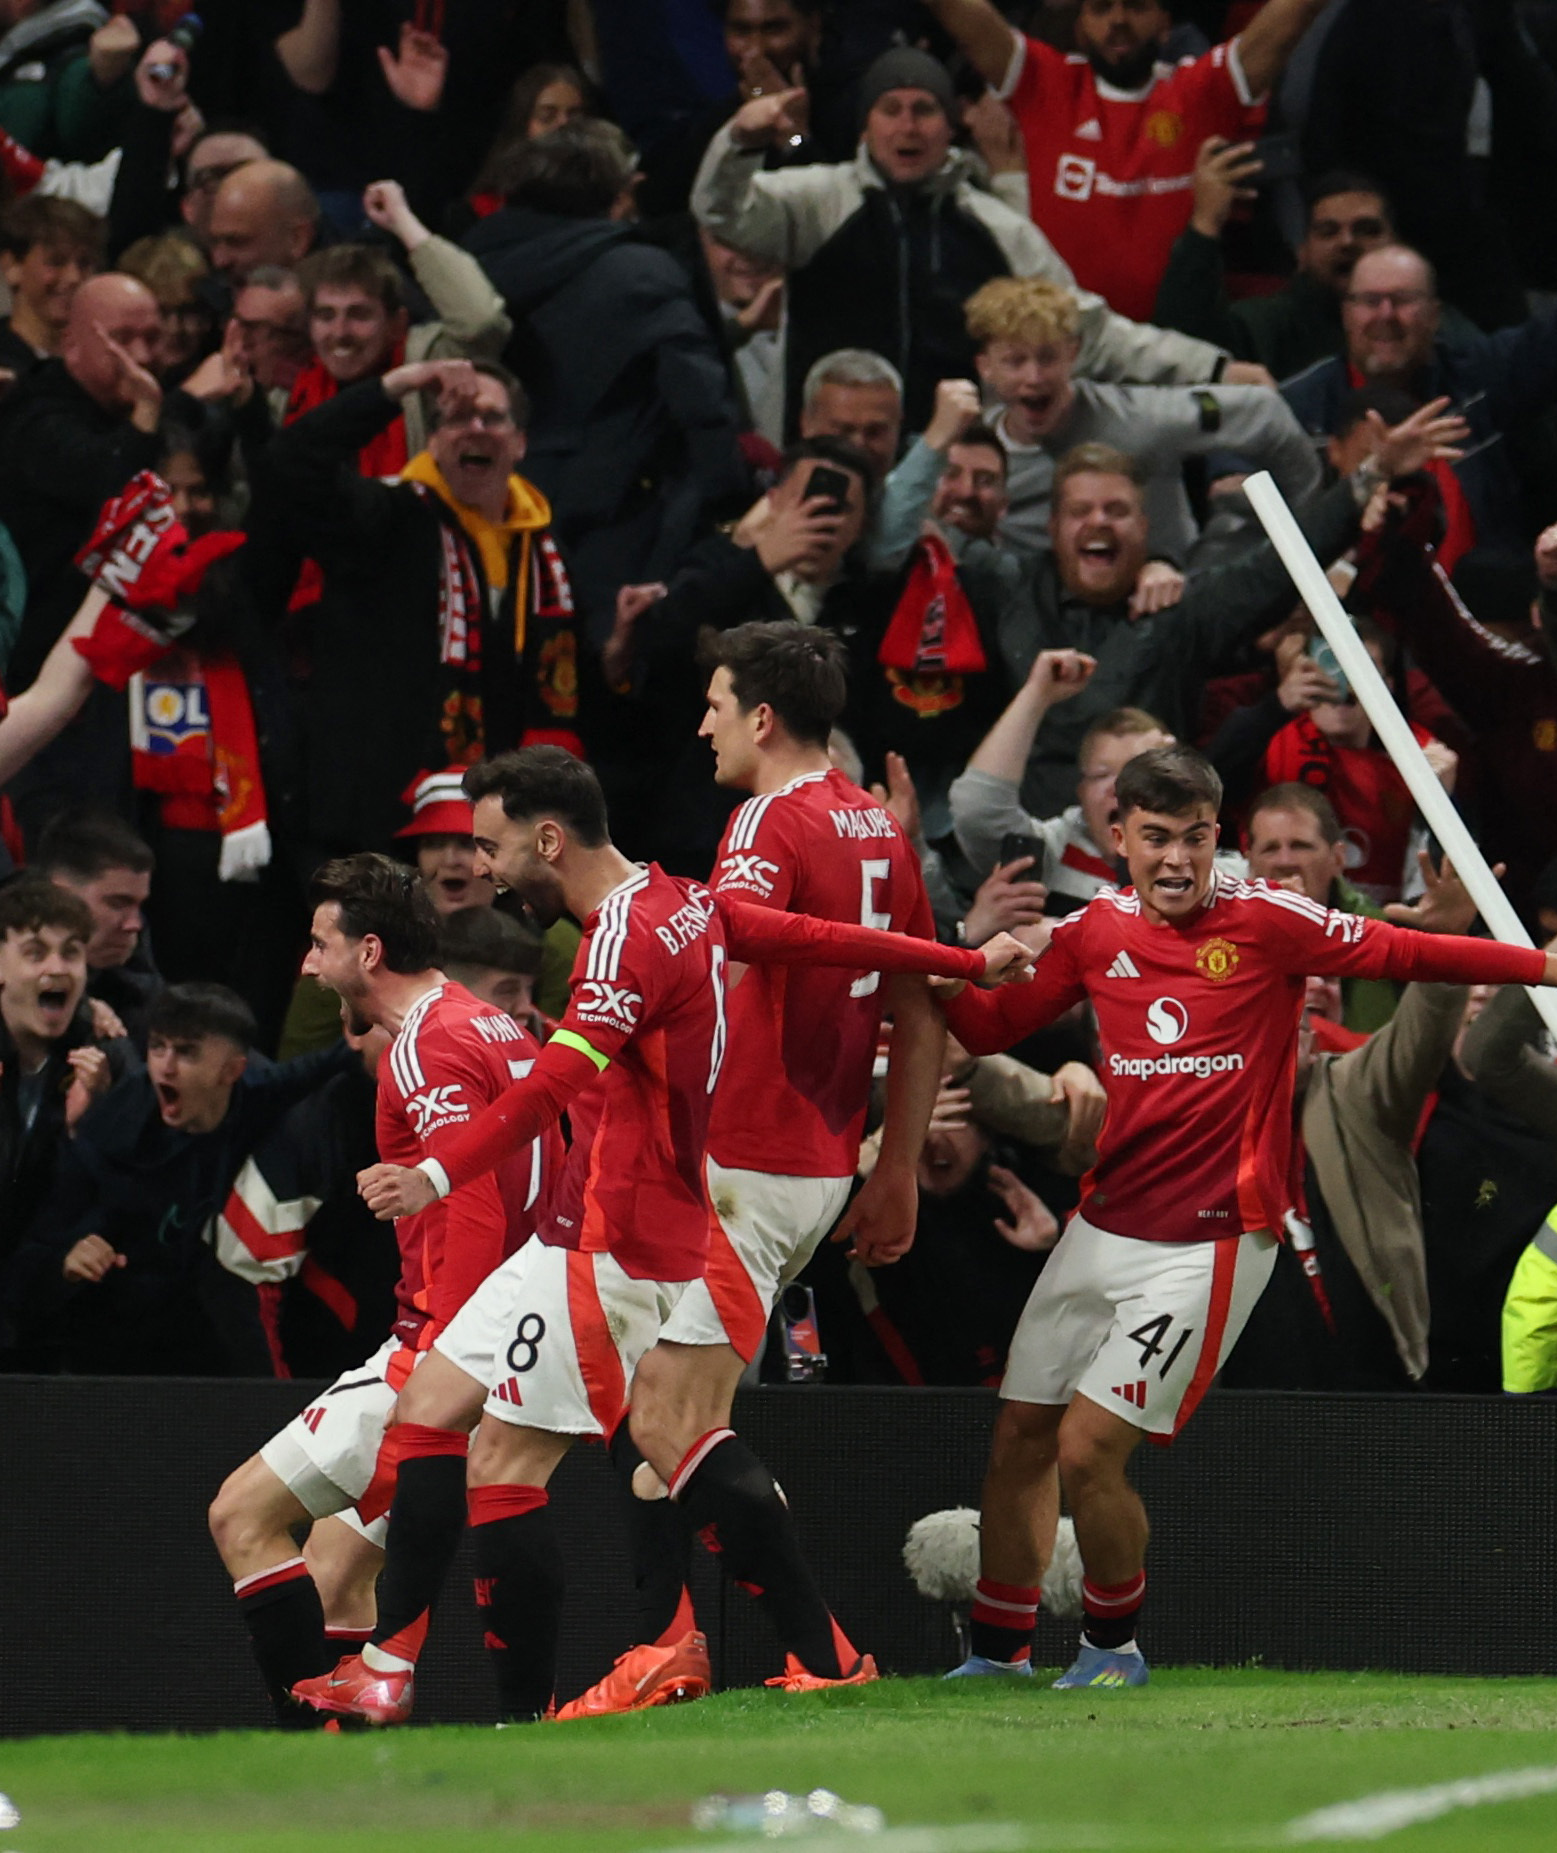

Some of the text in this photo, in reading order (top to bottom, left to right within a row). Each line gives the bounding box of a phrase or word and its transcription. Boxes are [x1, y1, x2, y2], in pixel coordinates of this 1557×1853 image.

[148, 686, 210, 726] OL
[715, 880, 771, 899] ECHNOLOGY
[1109, 1052, 1245, 1081] Snapdragon
[506, 1312, 546, 1373] 8
[1126, 1313, 1194, 1382] 41
